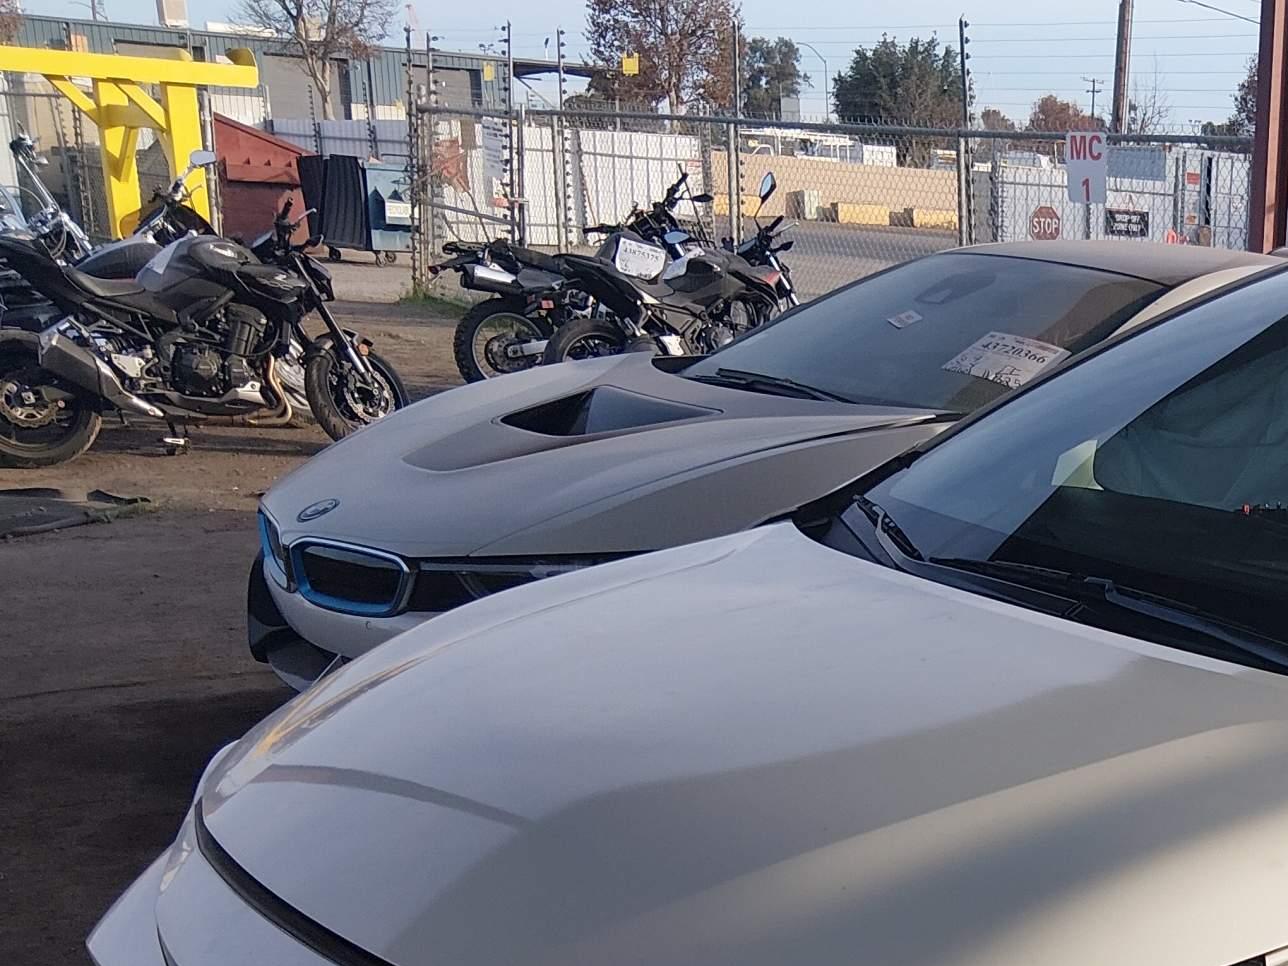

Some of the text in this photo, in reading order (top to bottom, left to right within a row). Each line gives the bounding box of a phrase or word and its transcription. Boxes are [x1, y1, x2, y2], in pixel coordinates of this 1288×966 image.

[1069, 135, 1102, 161] MC
[1081, 177, 1090, 202] 1
[1032, 219, 1060, 234] STOP
[1112, 222, 1142, 232] ZONE ONLY
